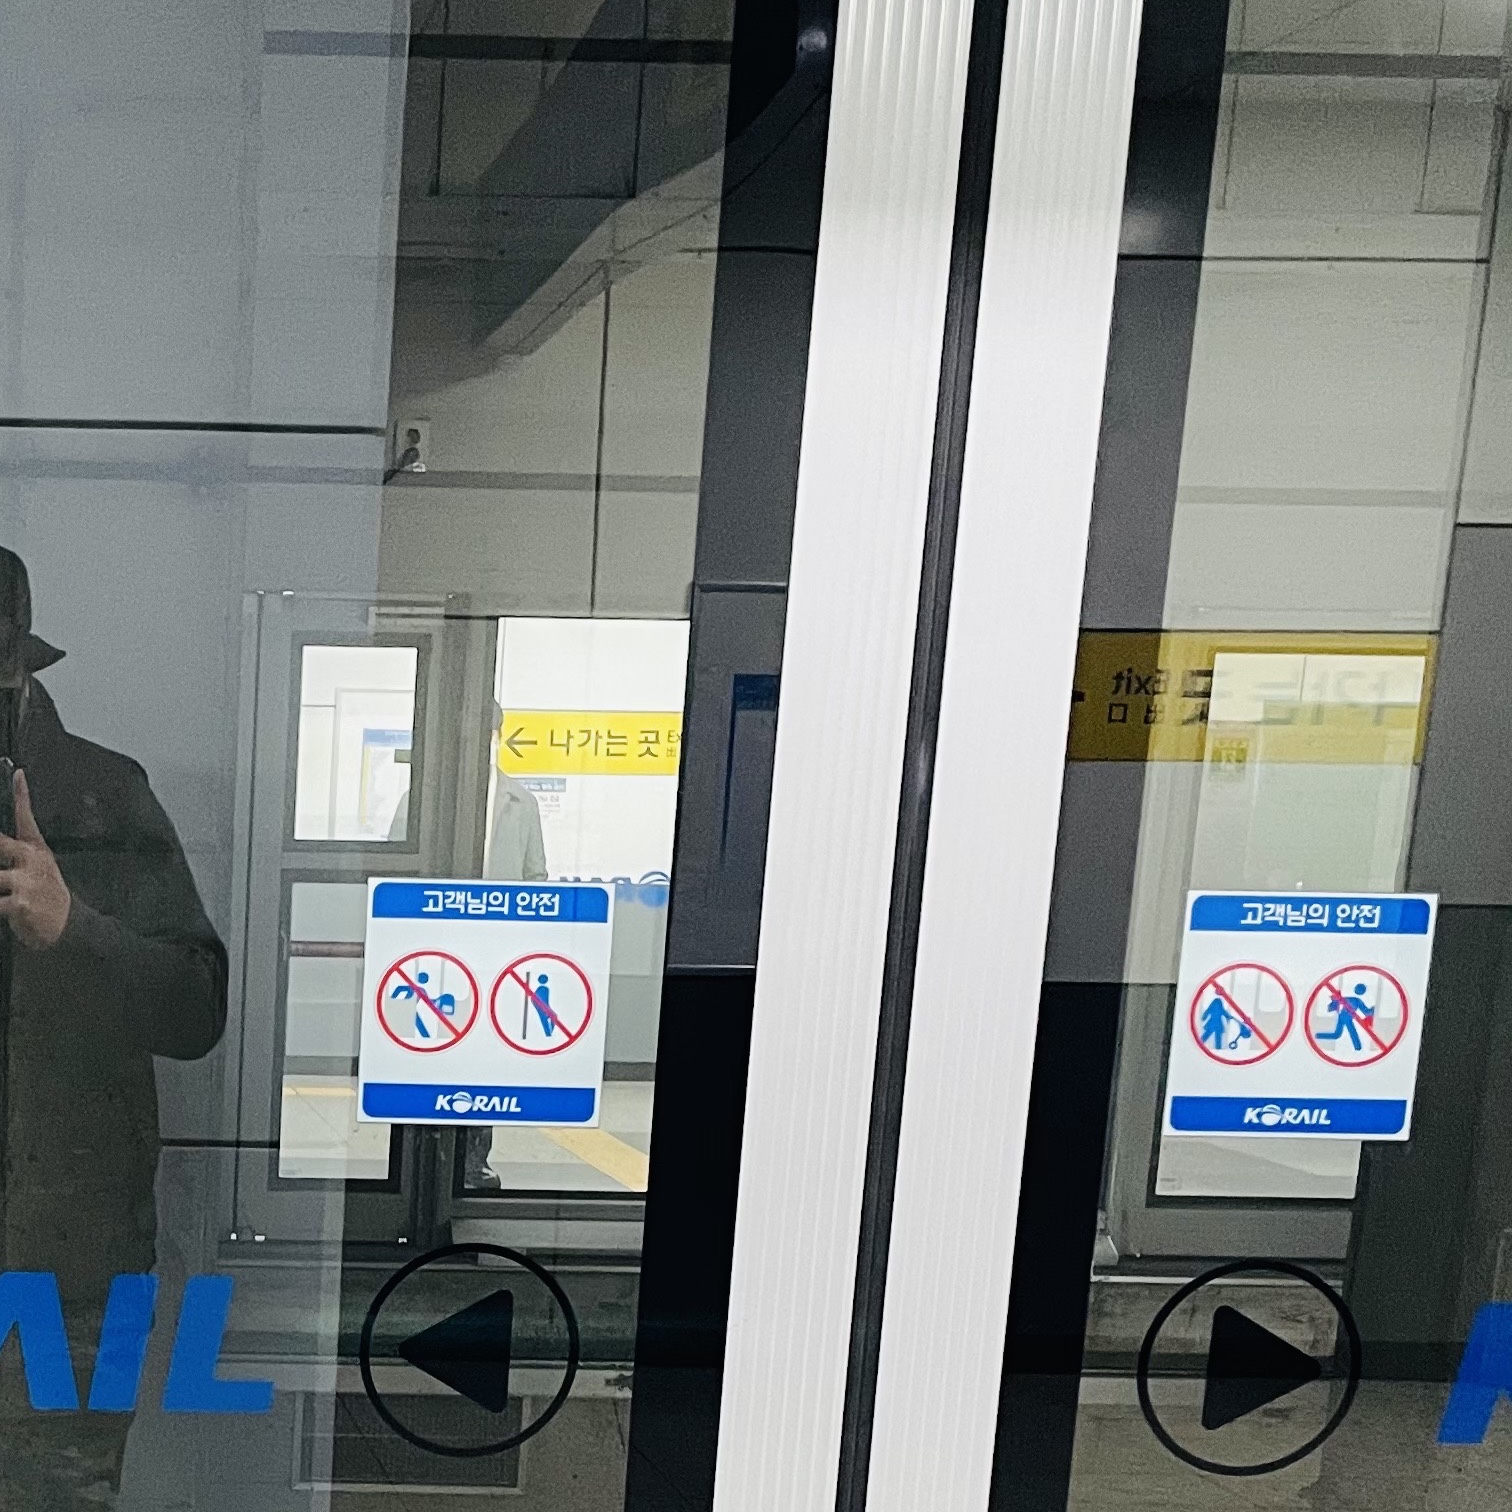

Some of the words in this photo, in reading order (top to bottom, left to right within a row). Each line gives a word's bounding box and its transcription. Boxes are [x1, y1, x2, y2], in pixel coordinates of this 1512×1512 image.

[549, 728, 628, 757] 나가는
[638, 729, 661, 758] 곳
[421, 890, 510, 915] 고객님의
[516, 891, 560, 916] 안전
[1240, 902, 1330, 927] 고객님의
[1336, 903, 1381, 928] 안전
[435, 1091, 522, 1114] KORAIL
[1243, 1104, 1331, 1126] KORAIL
